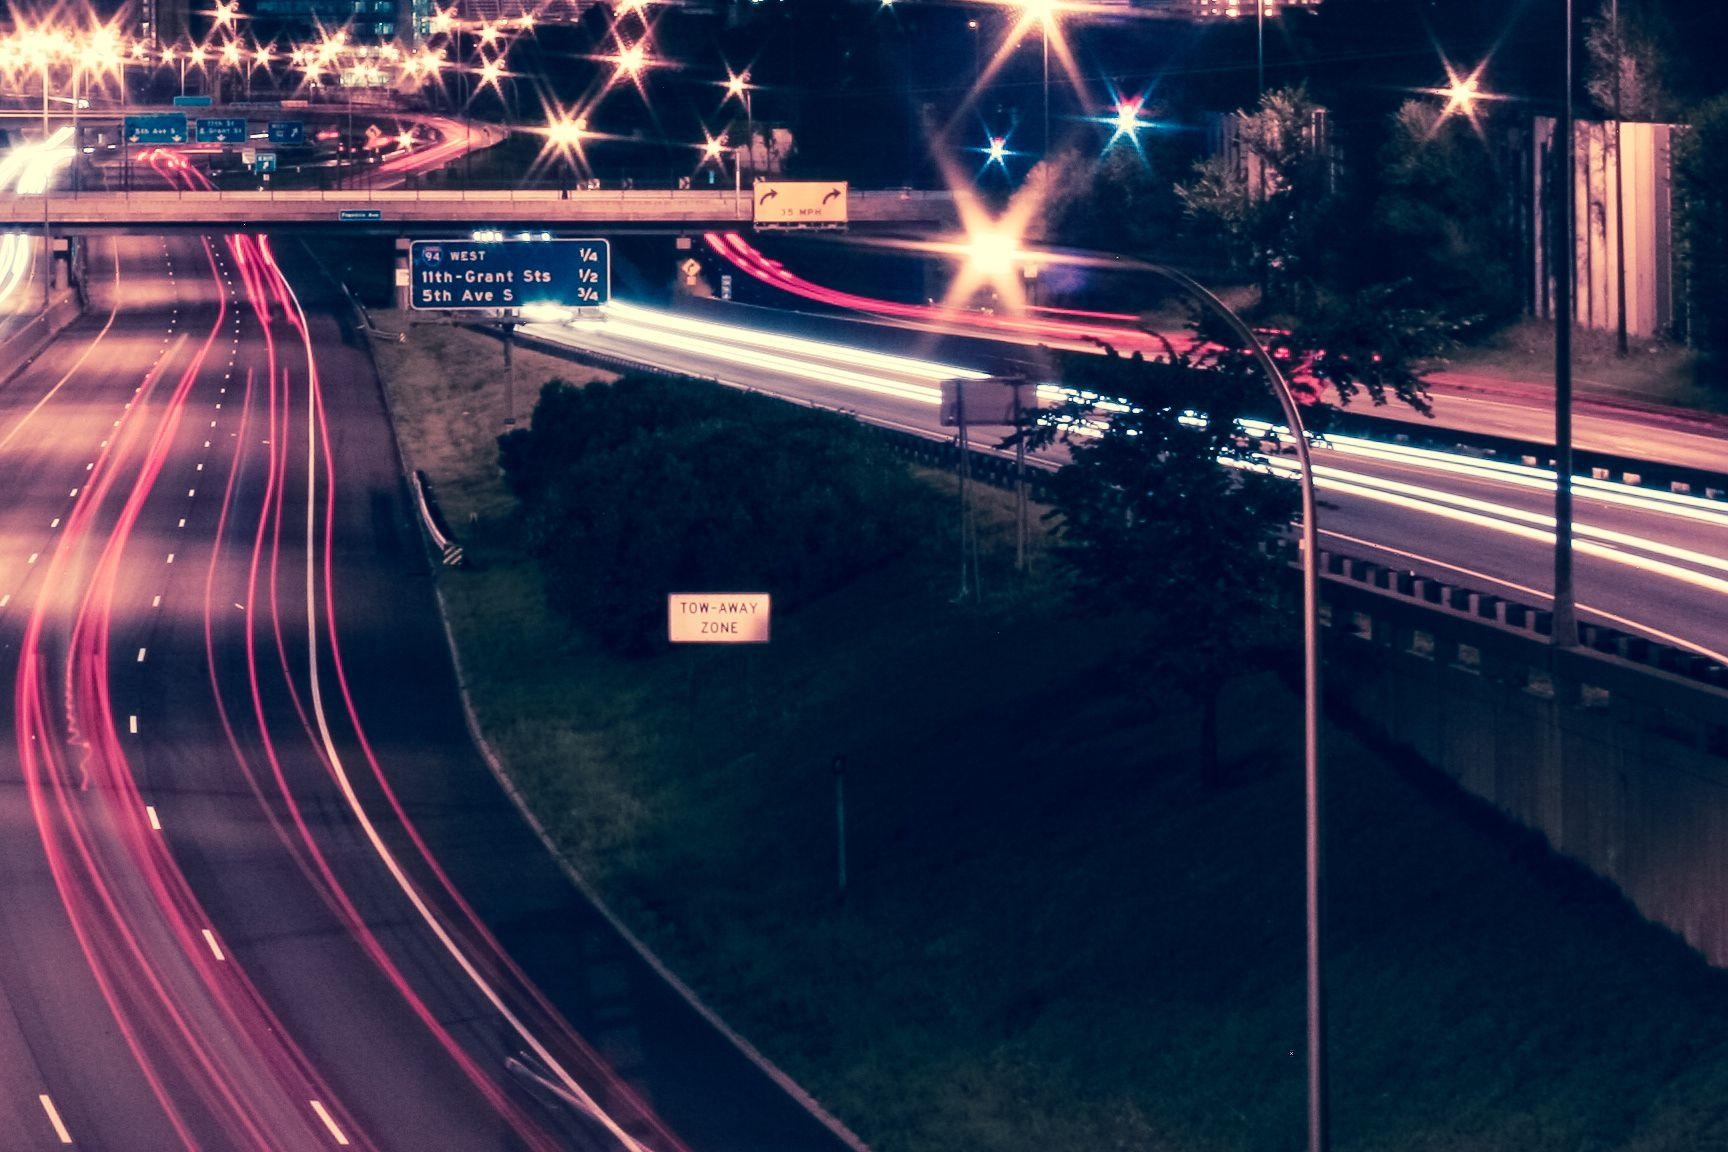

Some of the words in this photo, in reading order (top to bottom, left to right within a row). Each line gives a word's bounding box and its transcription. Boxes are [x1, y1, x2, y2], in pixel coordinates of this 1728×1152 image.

[799, 208, 822, 216] MPH
[425, 252, 440, 261] 94
[450, 251, 485, 261] WEST
[422, 270, 514, 283] 11th-Grant
[523, 269, 551, 282] Sts
[422, 289, 451, 302] 5th
[462, 289, 493, 302] Ave
[503, 288, 513, 301] S
[680, 602, 758, 614] TOW-AWAY
[700, 621, 738, 634] ZONE
